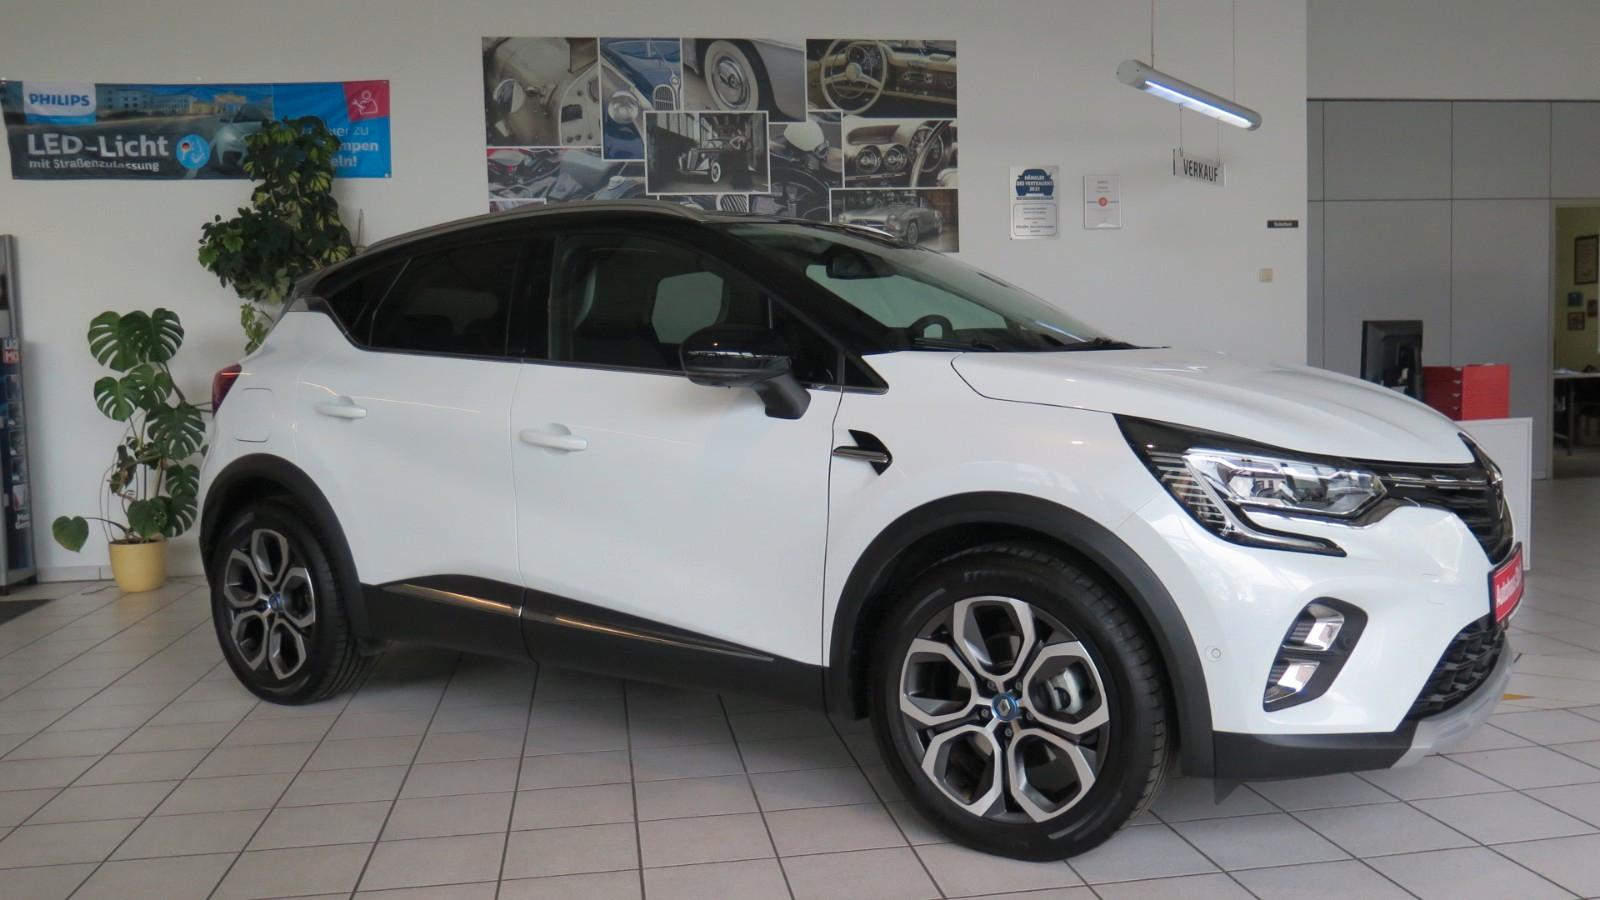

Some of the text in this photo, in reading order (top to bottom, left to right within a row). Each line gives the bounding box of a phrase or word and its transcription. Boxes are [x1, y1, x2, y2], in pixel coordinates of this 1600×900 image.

[29, 93, 90, 107] PHILIPS
[27, 133, 169, 158] LED-Licht
[29, 159, 51, 169] mit
[1183, 158, 1218, 182] VERKAUF
